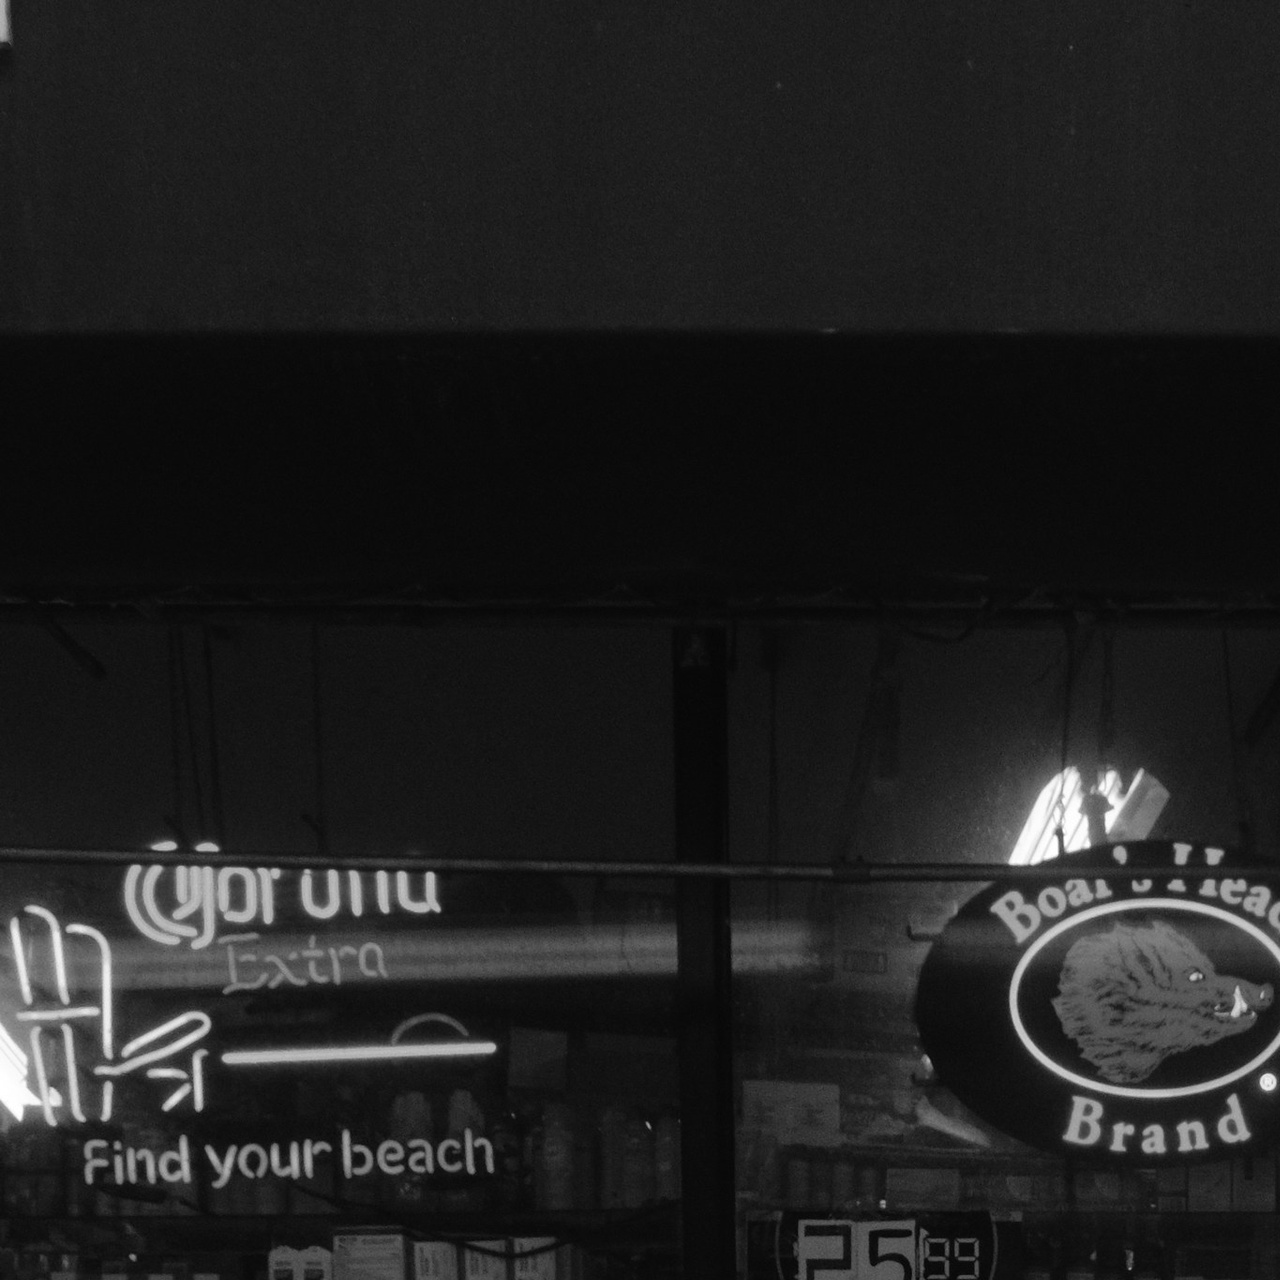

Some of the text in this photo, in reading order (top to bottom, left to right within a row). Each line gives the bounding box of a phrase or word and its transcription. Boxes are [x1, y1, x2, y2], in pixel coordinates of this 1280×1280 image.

[219, 933, 389, 995] Extra
[1063, 1093, 1253, 1155] Brand
[84, 1130, 494, 1189] Find your beach
